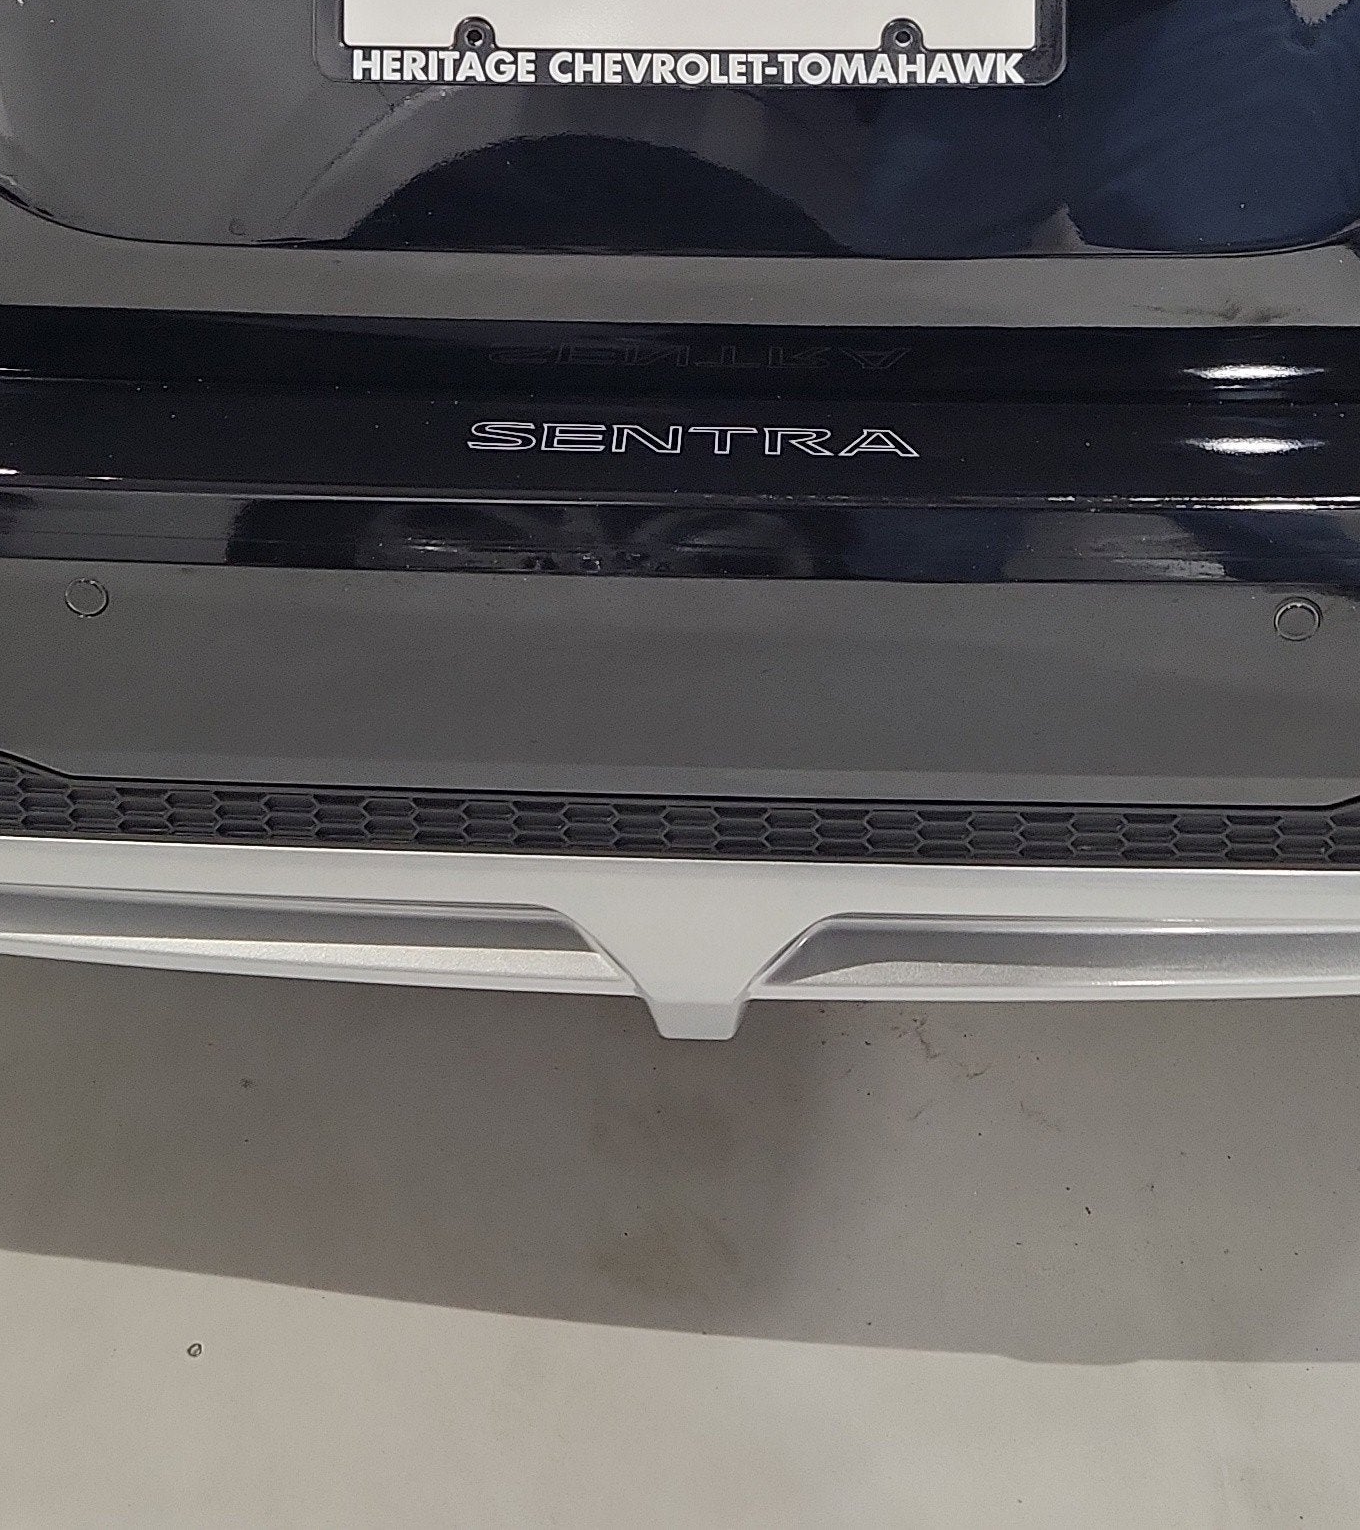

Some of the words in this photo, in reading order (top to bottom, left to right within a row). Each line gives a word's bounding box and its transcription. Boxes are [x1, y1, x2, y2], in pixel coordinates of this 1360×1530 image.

[352, 49, 536, 83] HERITAGE
[548, 51, 1024, 86] CHEVROLET-TOMAHAWK
[466, 421, 921, 458] SENTRA
